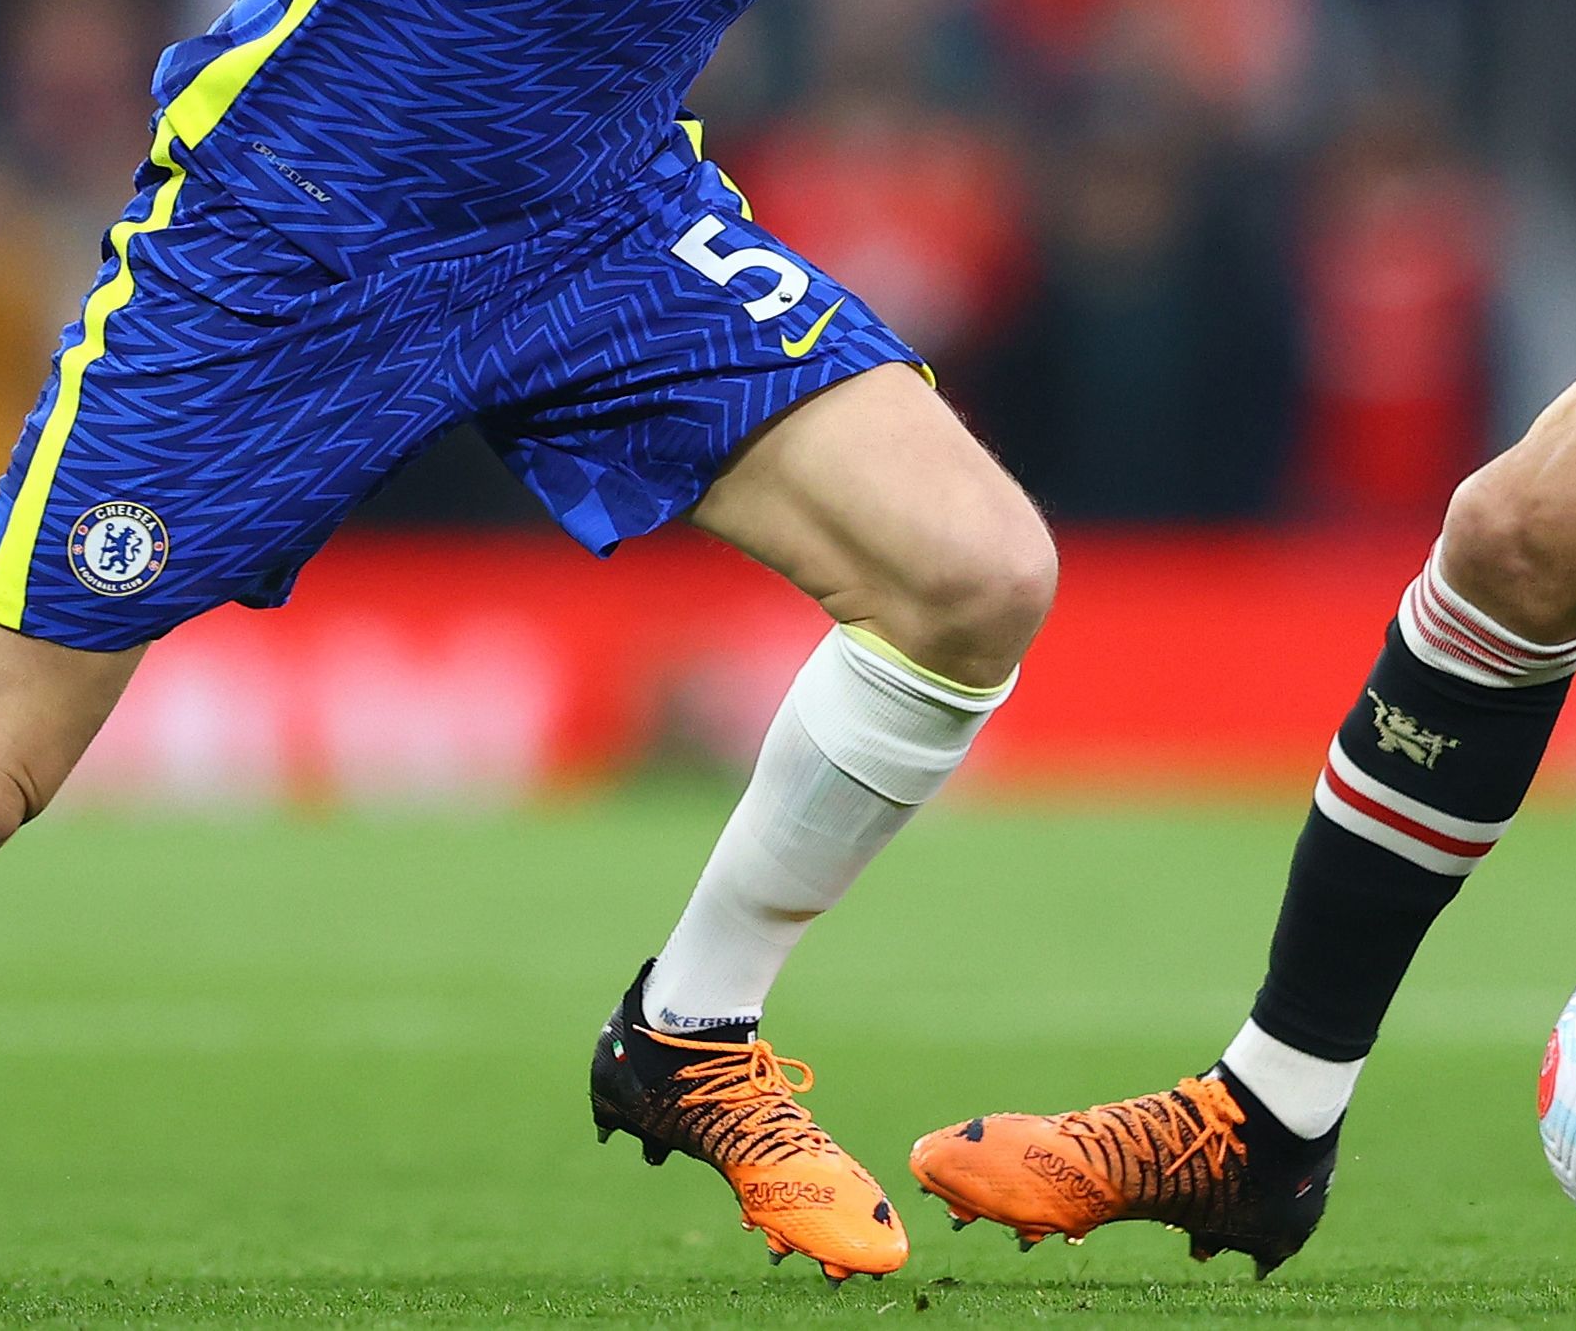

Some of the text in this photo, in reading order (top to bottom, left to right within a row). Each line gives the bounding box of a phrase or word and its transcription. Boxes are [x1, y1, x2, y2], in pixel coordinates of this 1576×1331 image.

[670, 213, 810, 323] 5
[95, 505, 157, 531] CHELSEA
[120, 578, 143, 591] CLUB
[744, 1181, 836, 1204] FUTURE
